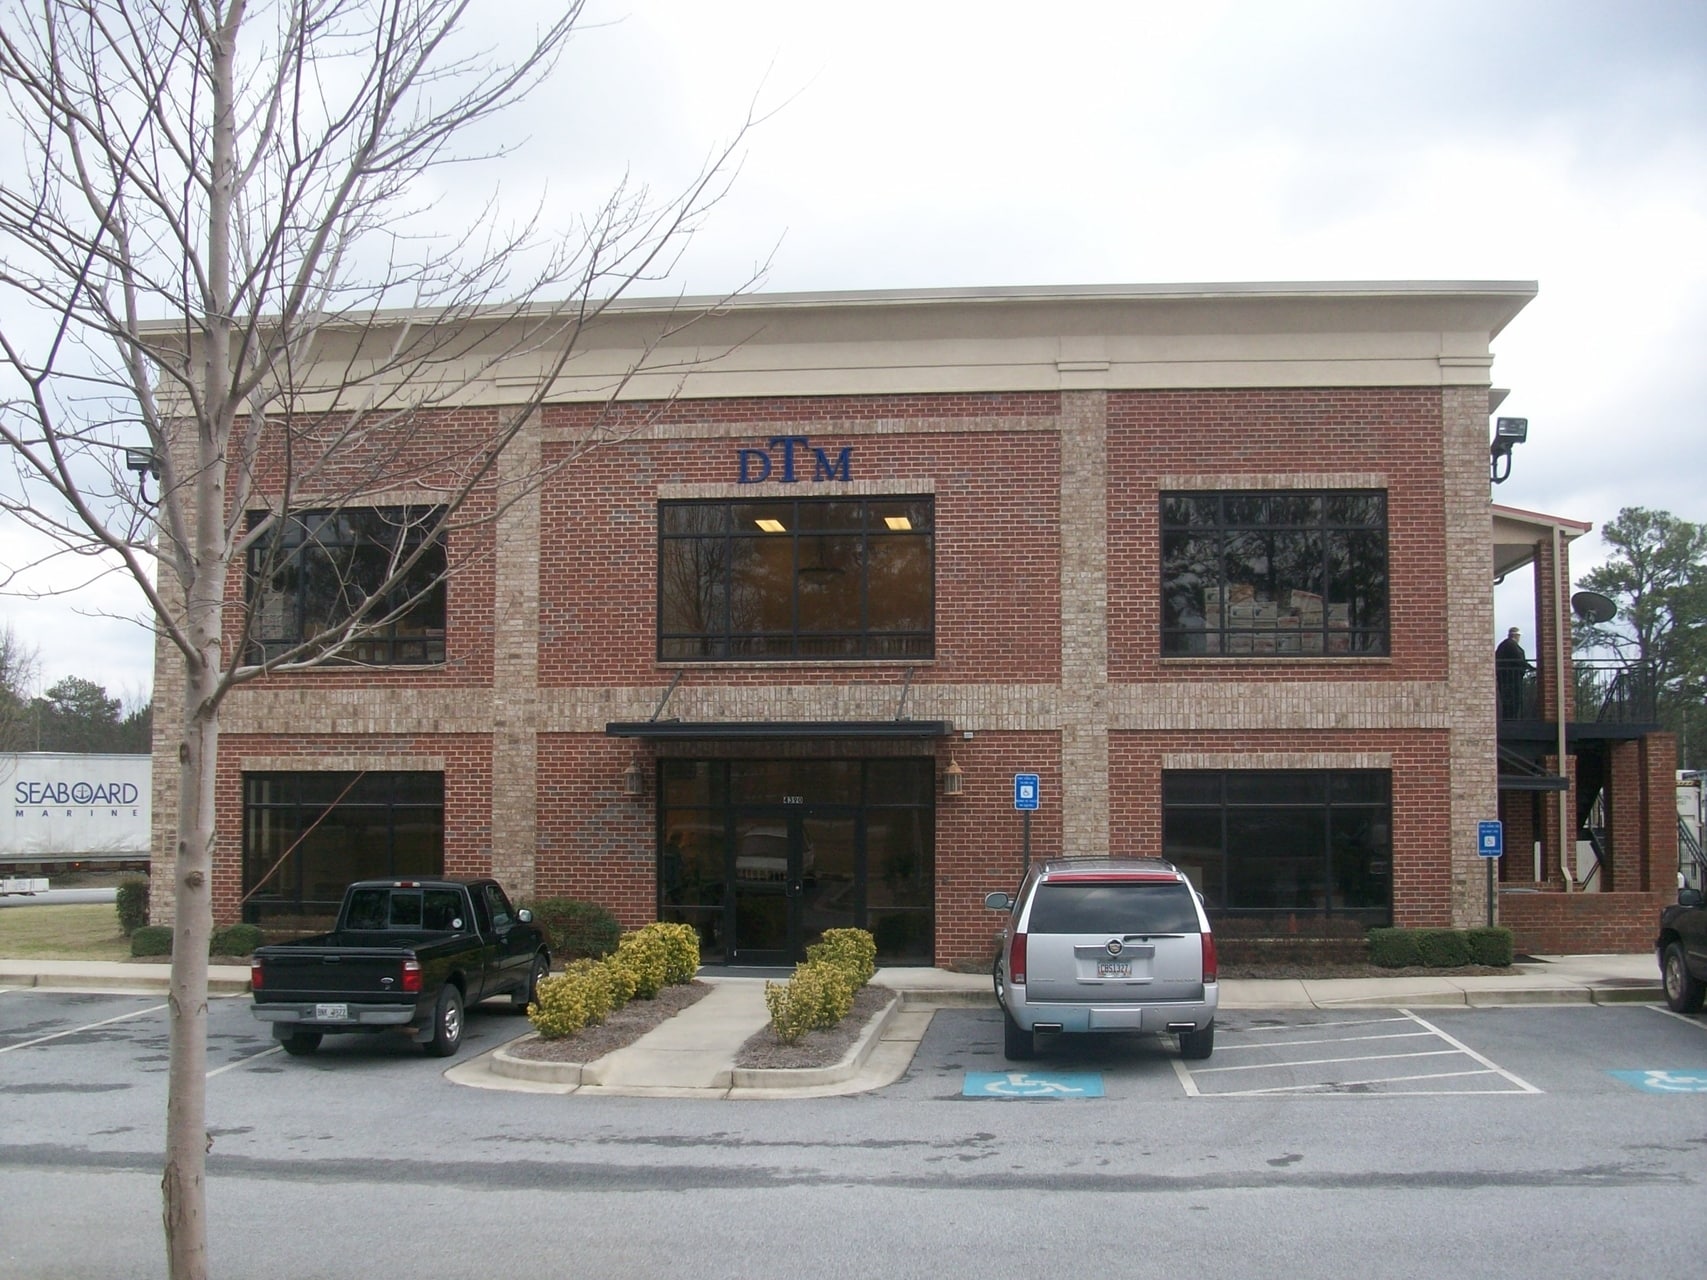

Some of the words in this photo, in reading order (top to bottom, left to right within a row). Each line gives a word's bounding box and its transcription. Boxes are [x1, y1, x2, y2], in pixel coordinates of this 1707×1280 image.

[736, 434, 854, 484] DTM
[15, 781, 138, 804] SEABOARD
[15, 809, 138, 817] MARINE
